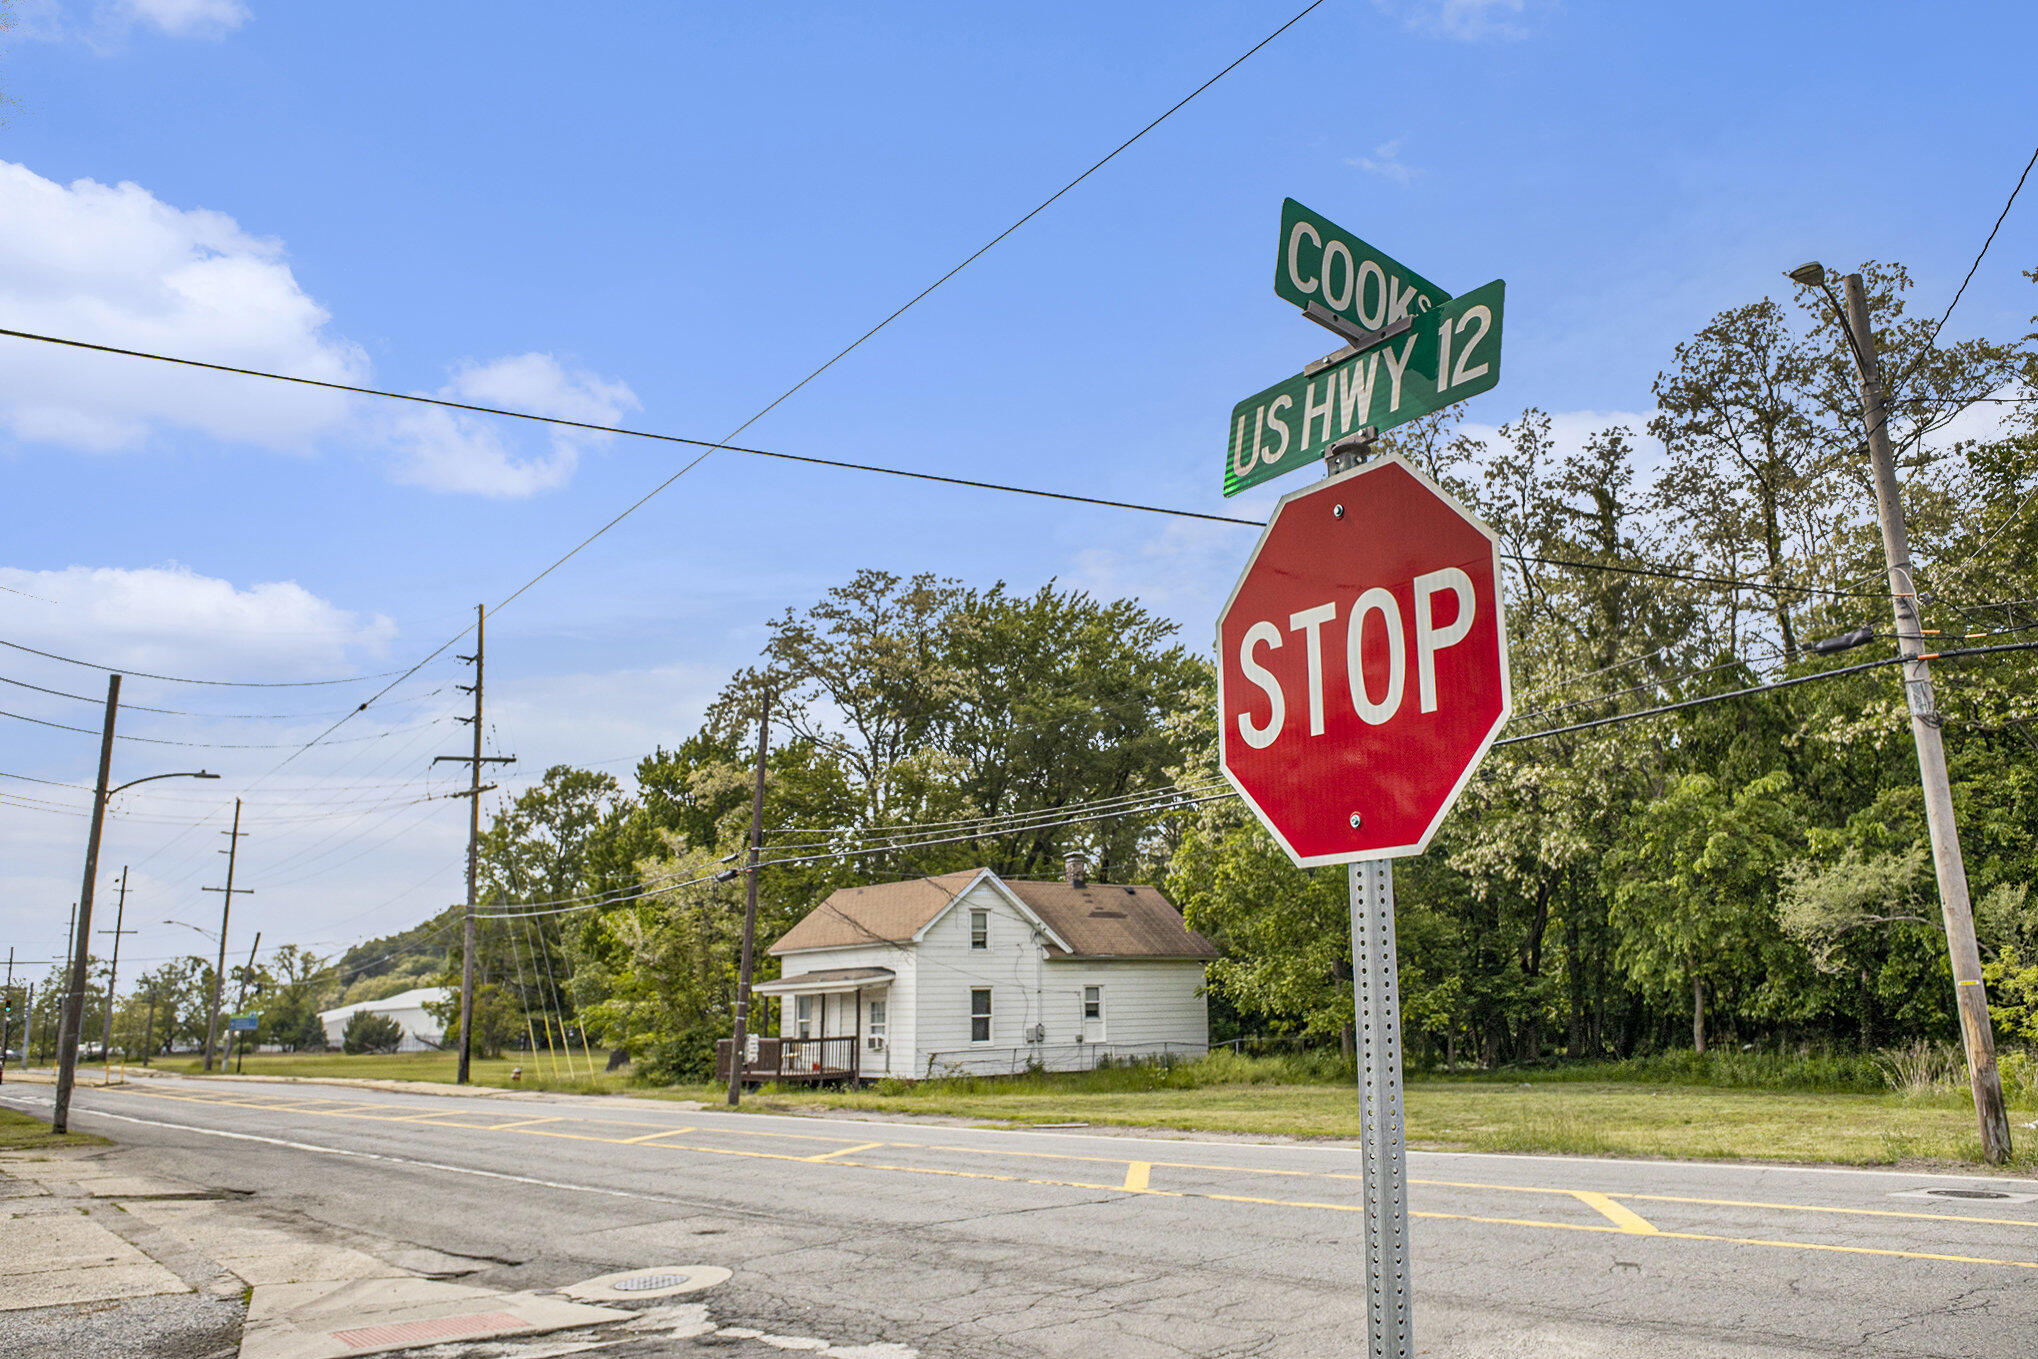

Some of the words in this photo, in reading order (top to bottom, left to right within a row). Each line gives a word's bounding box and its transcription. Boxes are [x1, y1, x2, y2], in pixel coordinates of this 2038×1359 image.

[1289, 222, 1417, 330] COOK
[1232, 394, 1293, 477] US
[1301, 333, 1418, 452] HWY
[1437, 305, 1493, 393] 12
[1238, 567, 1476, 749] STOP
